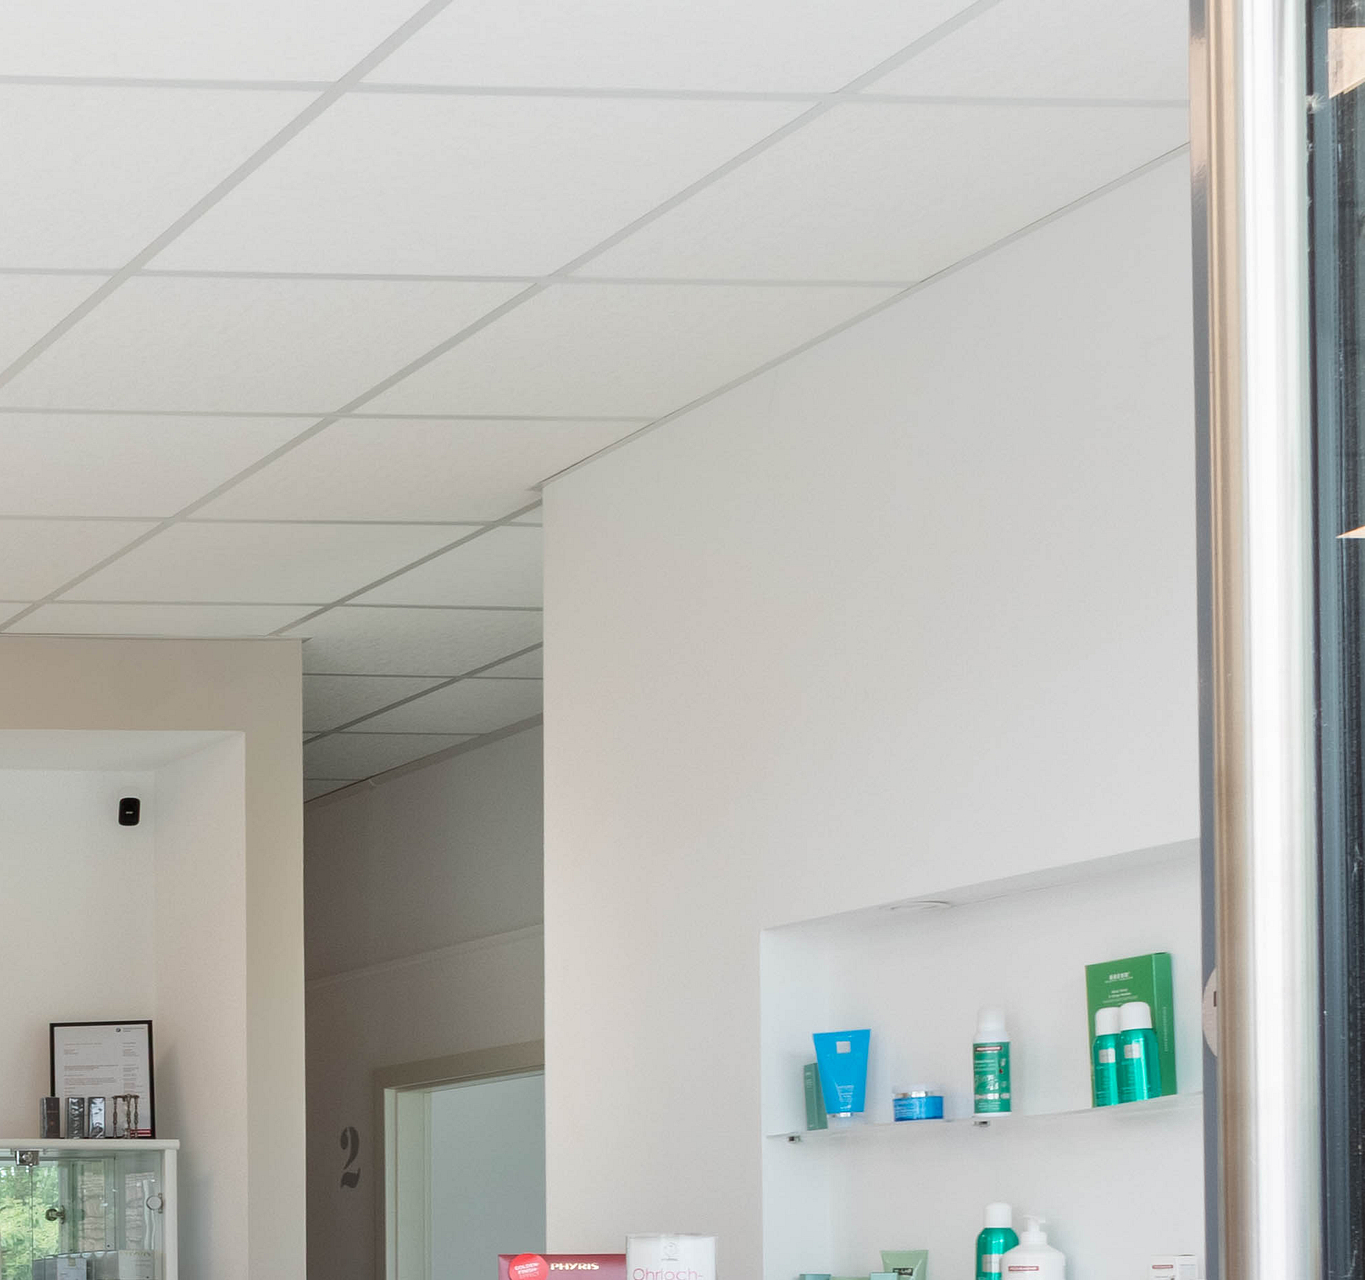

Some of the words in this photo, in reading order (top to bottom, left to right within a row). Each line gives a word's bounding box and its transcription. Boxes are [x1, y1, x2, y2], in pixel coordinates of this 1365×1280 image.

[340, 1126, 361, 1189] 2
[550, 1262, 600, 1271] PHYRIS
[633, 1267, 703, 1280] Ohrloch-
